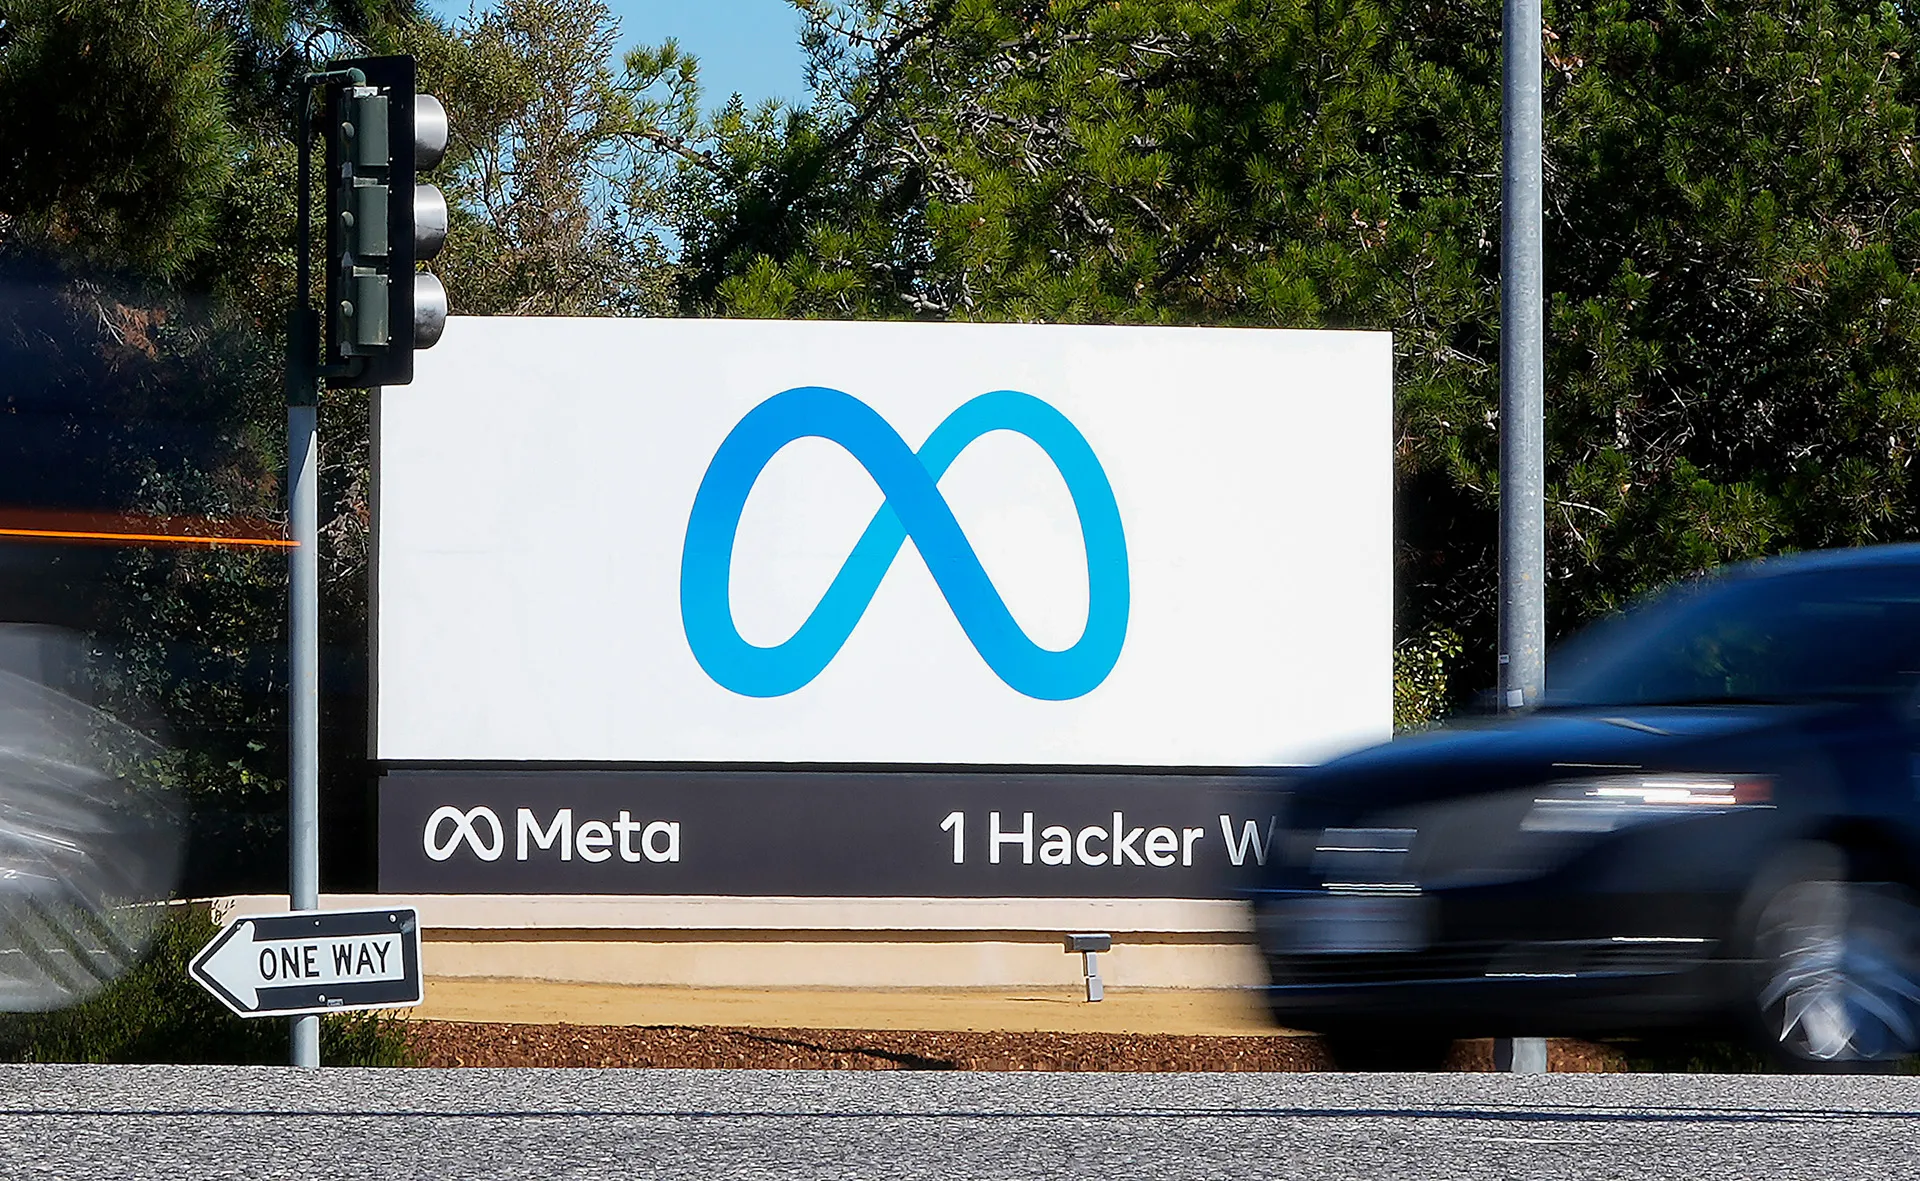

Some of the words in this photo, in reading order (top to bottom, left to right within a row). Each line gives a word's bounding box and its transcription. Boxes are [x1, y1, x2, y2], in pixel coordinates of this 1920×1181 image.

[516, 807, 681, 863] Meta
[939, 811, 966, 864] 1
[988, 811, 1205, 867] Hacker
[259, 945, 320, 981] ONE
[332, 941, 391, 977] WAY
